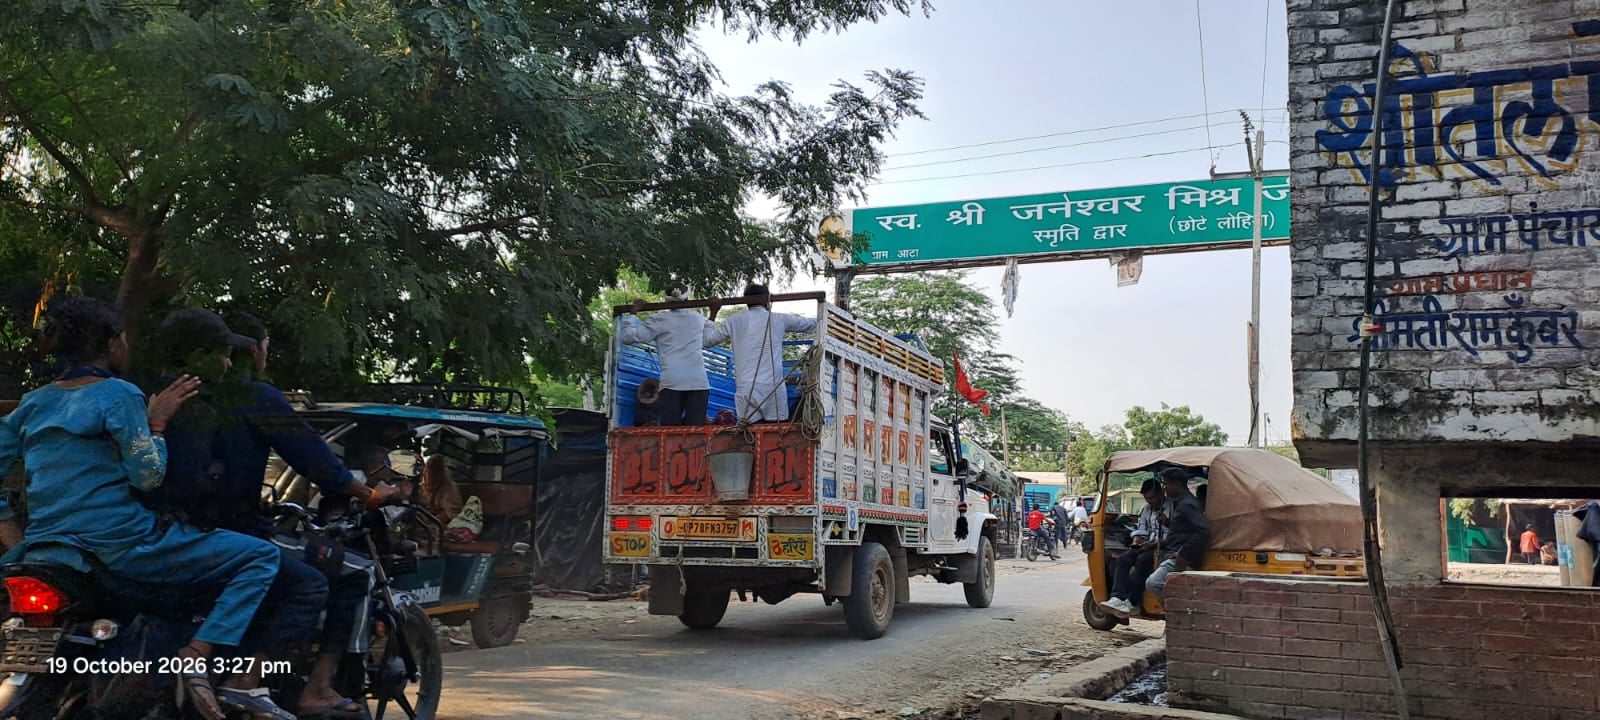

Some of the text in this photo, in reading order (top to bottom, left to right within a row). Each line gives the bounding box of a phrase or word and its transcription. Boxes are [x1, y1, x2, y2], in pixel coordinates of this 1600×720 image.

[875, 213, 921, 231] स्व.
[946, 202, 986, 226] श्री
[1009, 193, 1146, 221] जनेश्वर
[1164, 185, 1242, 210] मिश्र
[1169, 211, 1275, 234] (छोटे लोहिा)
[1032, 223, 1128, 247] स्मृति द्वार
[1435, 215, 1512, 261] ग्राम
[897, 249, 919, 259] आटा
[613, 536, 647, 554] STOP
